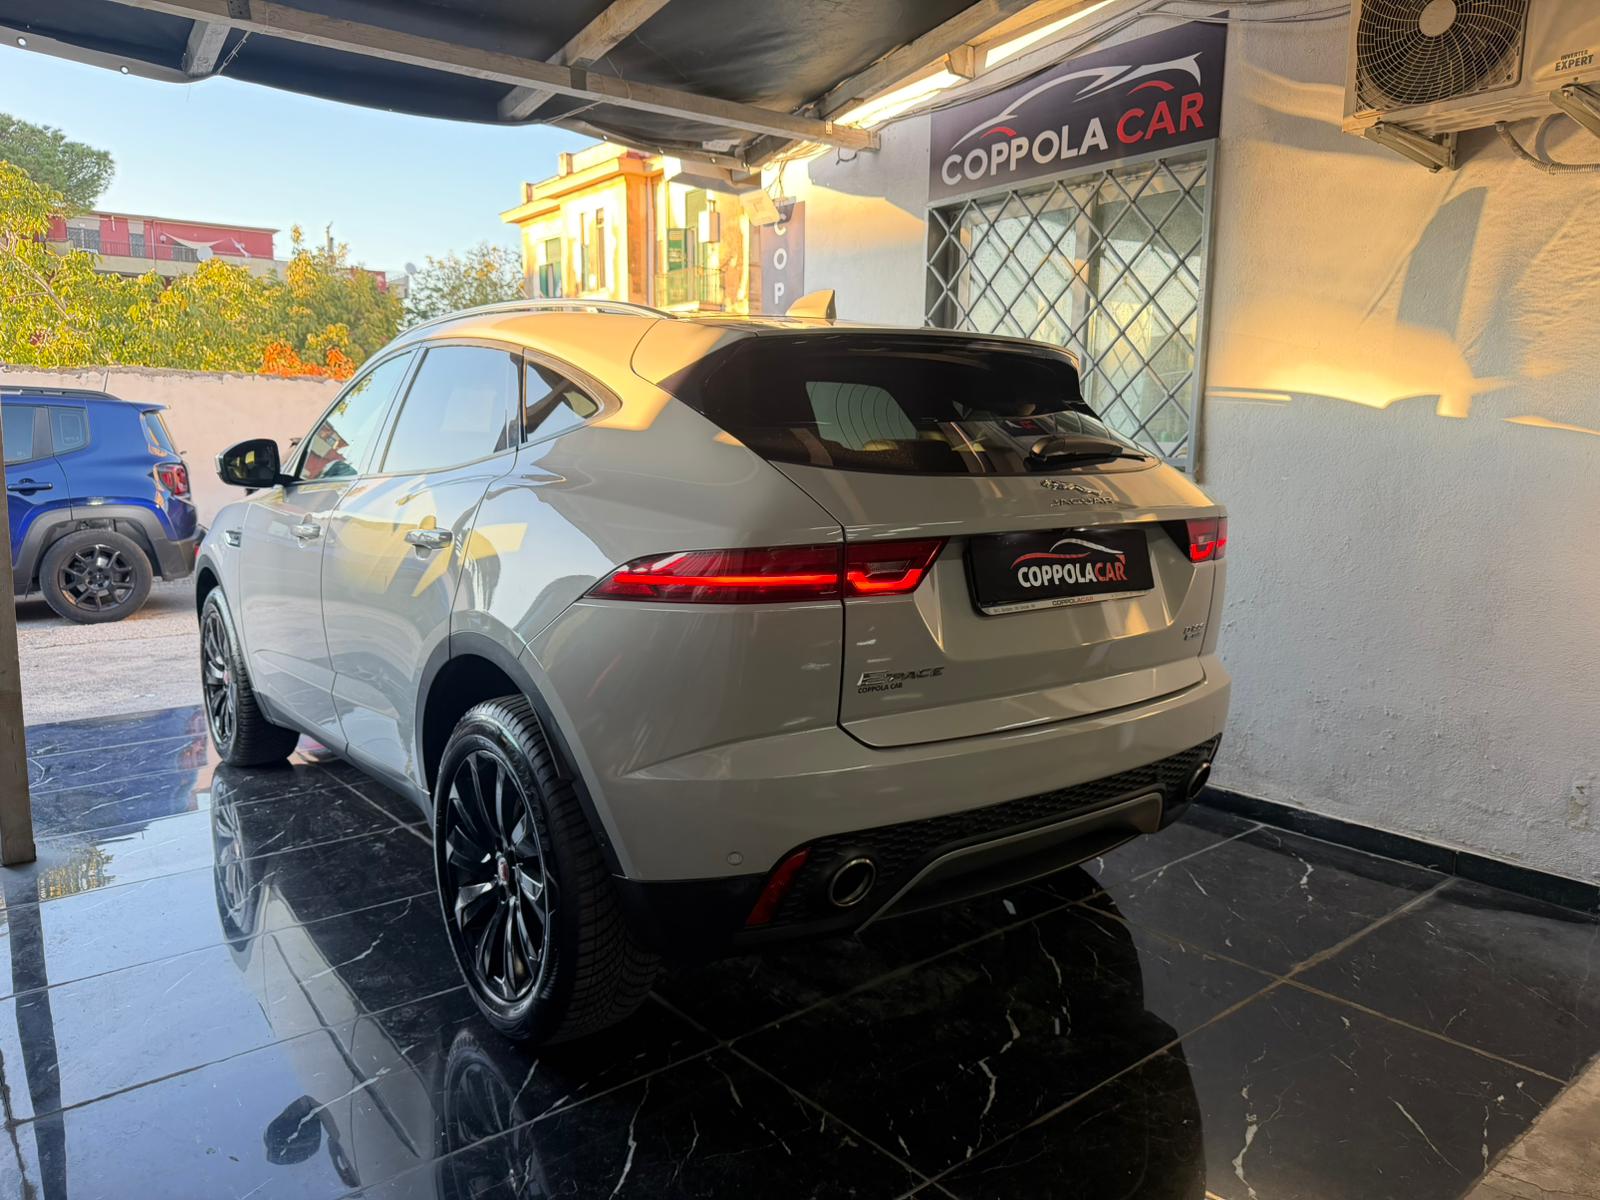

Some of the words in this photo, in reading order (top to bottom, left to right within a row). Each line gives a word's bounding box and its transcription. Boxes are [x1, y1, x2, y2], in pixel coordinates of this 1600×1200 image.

[1555, 54, 1594, 72] EXPERT
[941, 117, 1109, 186] COPPOLA
[1116, 92, 1205, 144] CAR
[1049, 496, 1116, 508] JAGUAR
